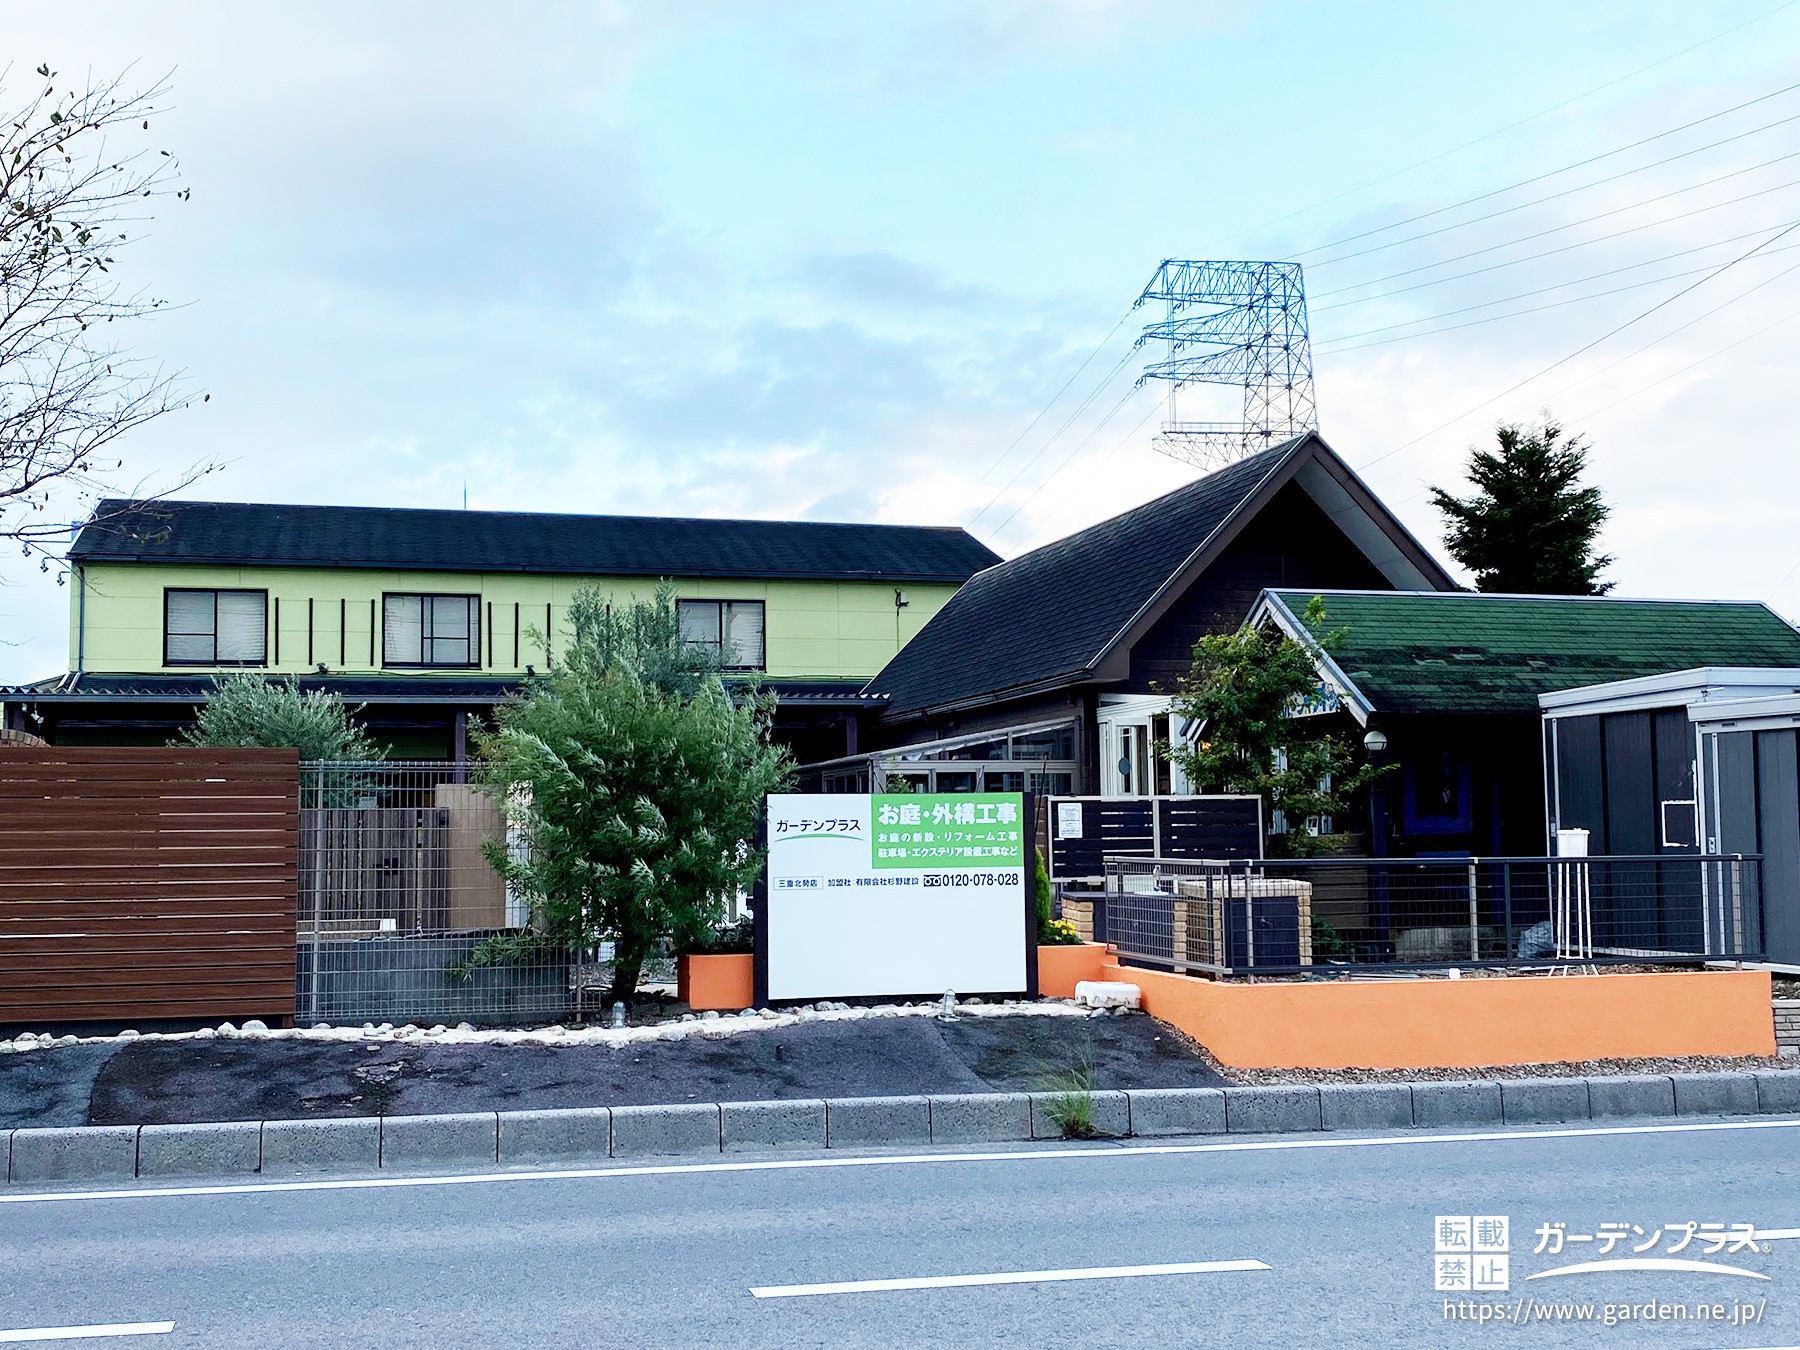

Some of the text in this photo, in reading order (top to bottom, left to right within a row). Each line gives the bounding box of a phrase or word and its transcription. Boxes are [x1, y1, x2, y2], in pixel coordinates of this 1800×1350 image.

[878, 802, 1017, 826] お庭・外構工事
[776, 818, 861, 833] ガーデンプラス
[877, 830, 1018, 843] お庭の新設・リフォーム工事
[942, 873, 1019, 887] 0120-078-028
